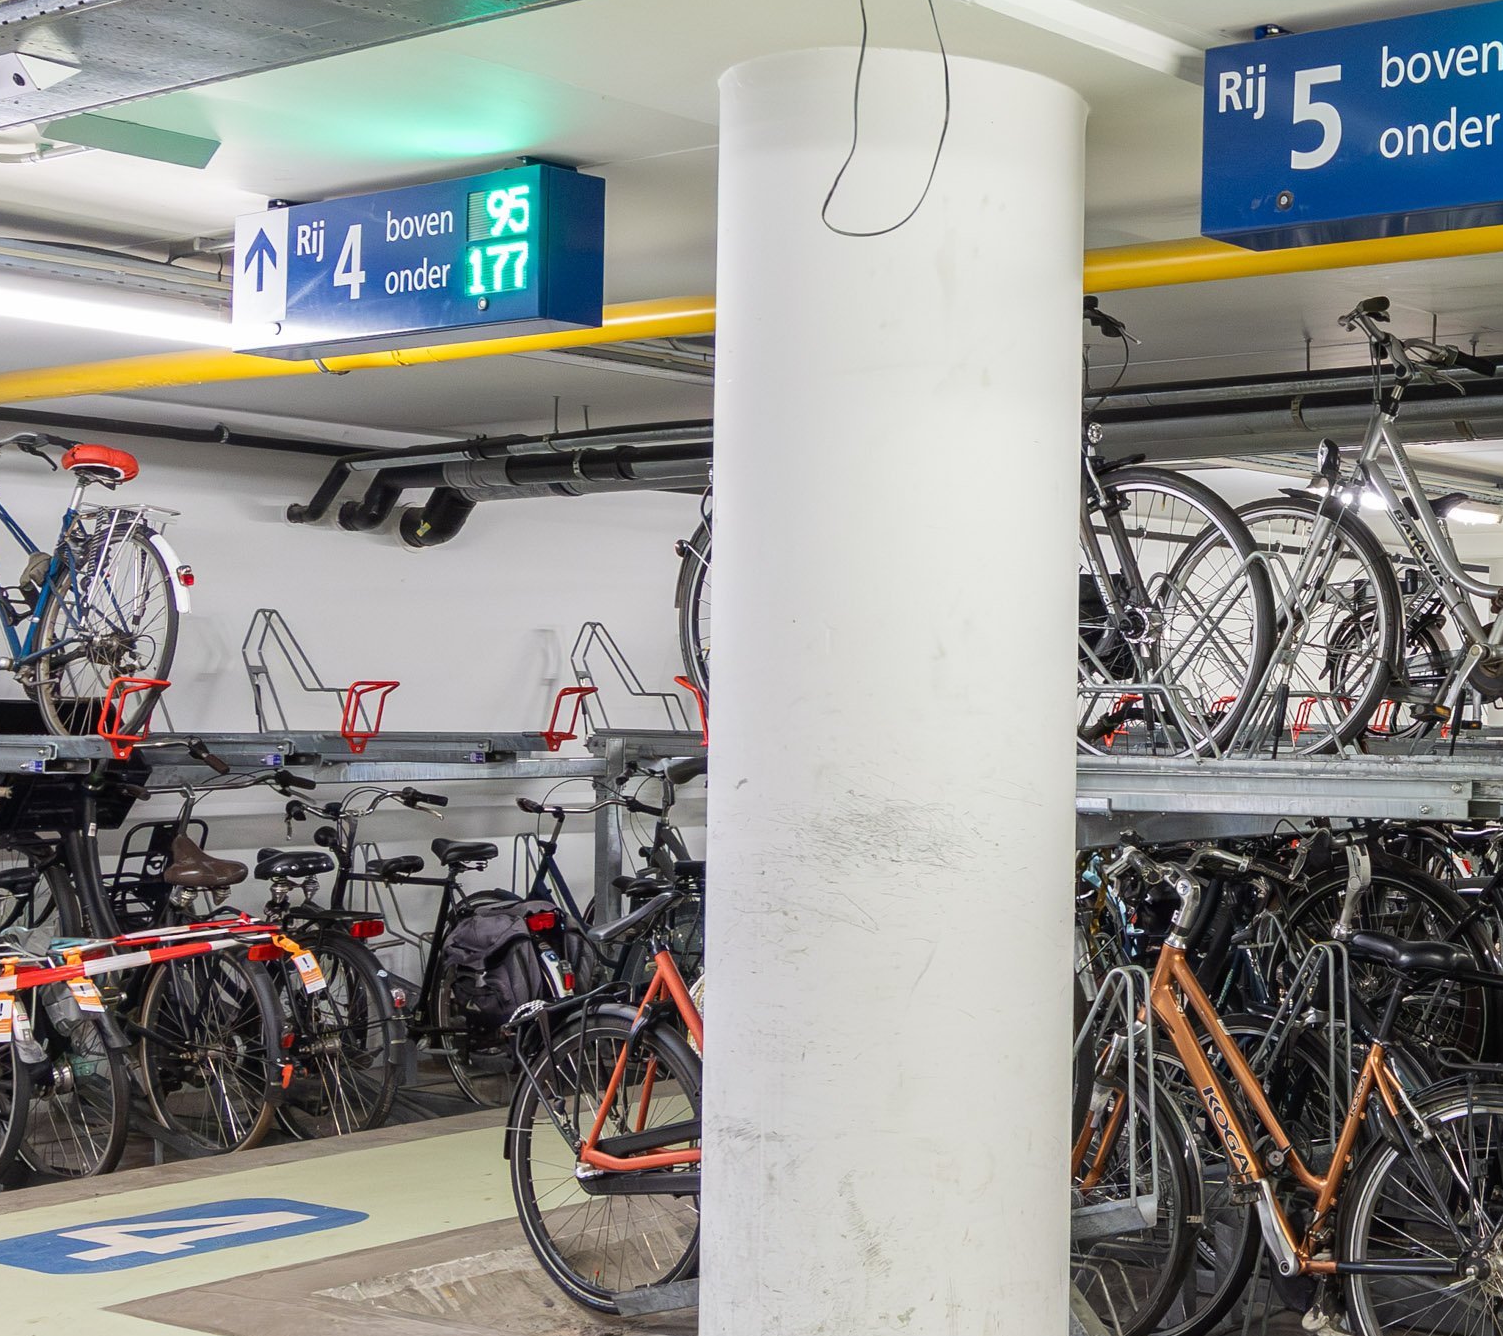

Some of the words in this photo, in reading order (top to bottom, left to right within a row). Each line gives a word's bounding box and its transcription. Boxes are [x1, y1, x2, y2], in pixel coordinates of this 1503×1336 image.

[1218, 64, 1268, 120] Rij
[1290, 64, 1343, 170] 5
[1379, 106, 1501, 159] onder
[385, 209, 453, 242] boven
[486, 184, 530, 237] 95
[296, 219, 325, 262] Rij
[333, 223, 366, 300] 4
[384, 257, 451, 295] onder
[467, 241, 529, 294] 177
[1393, 509, 1446, 587] BATAVUS
[1201, 1086, 1251, 1175] KOGA
[56, 1210, 320, 1262] 4
